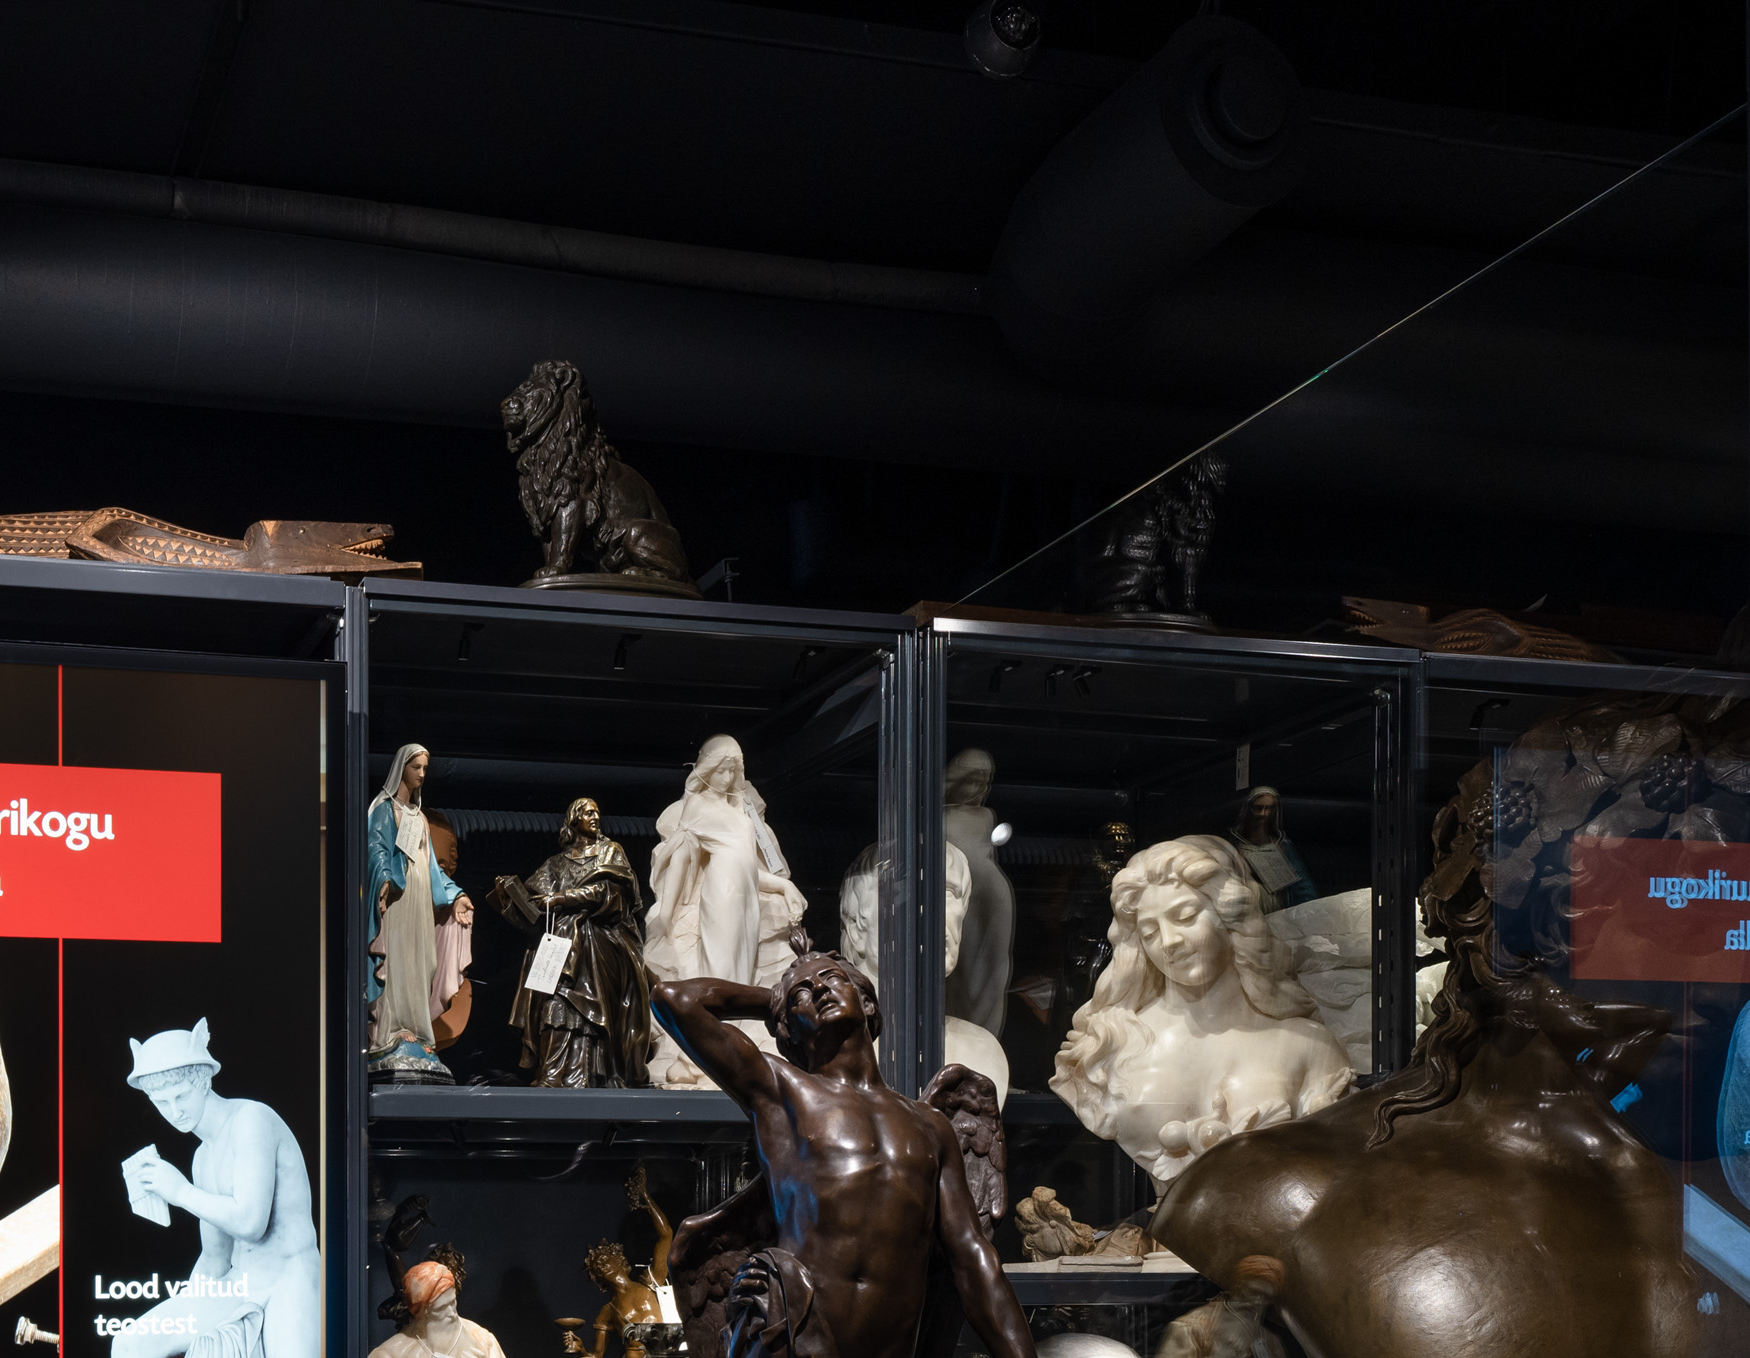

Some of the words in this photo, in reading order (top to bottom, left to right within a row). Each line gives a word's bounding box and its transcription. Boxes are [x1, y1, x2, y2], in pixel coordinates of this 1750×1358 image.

[94, 1273, 160, 1300] Lood
[164, 1272, 249, 1298] valitud
[93, 1313, 198, 1336] teostest
